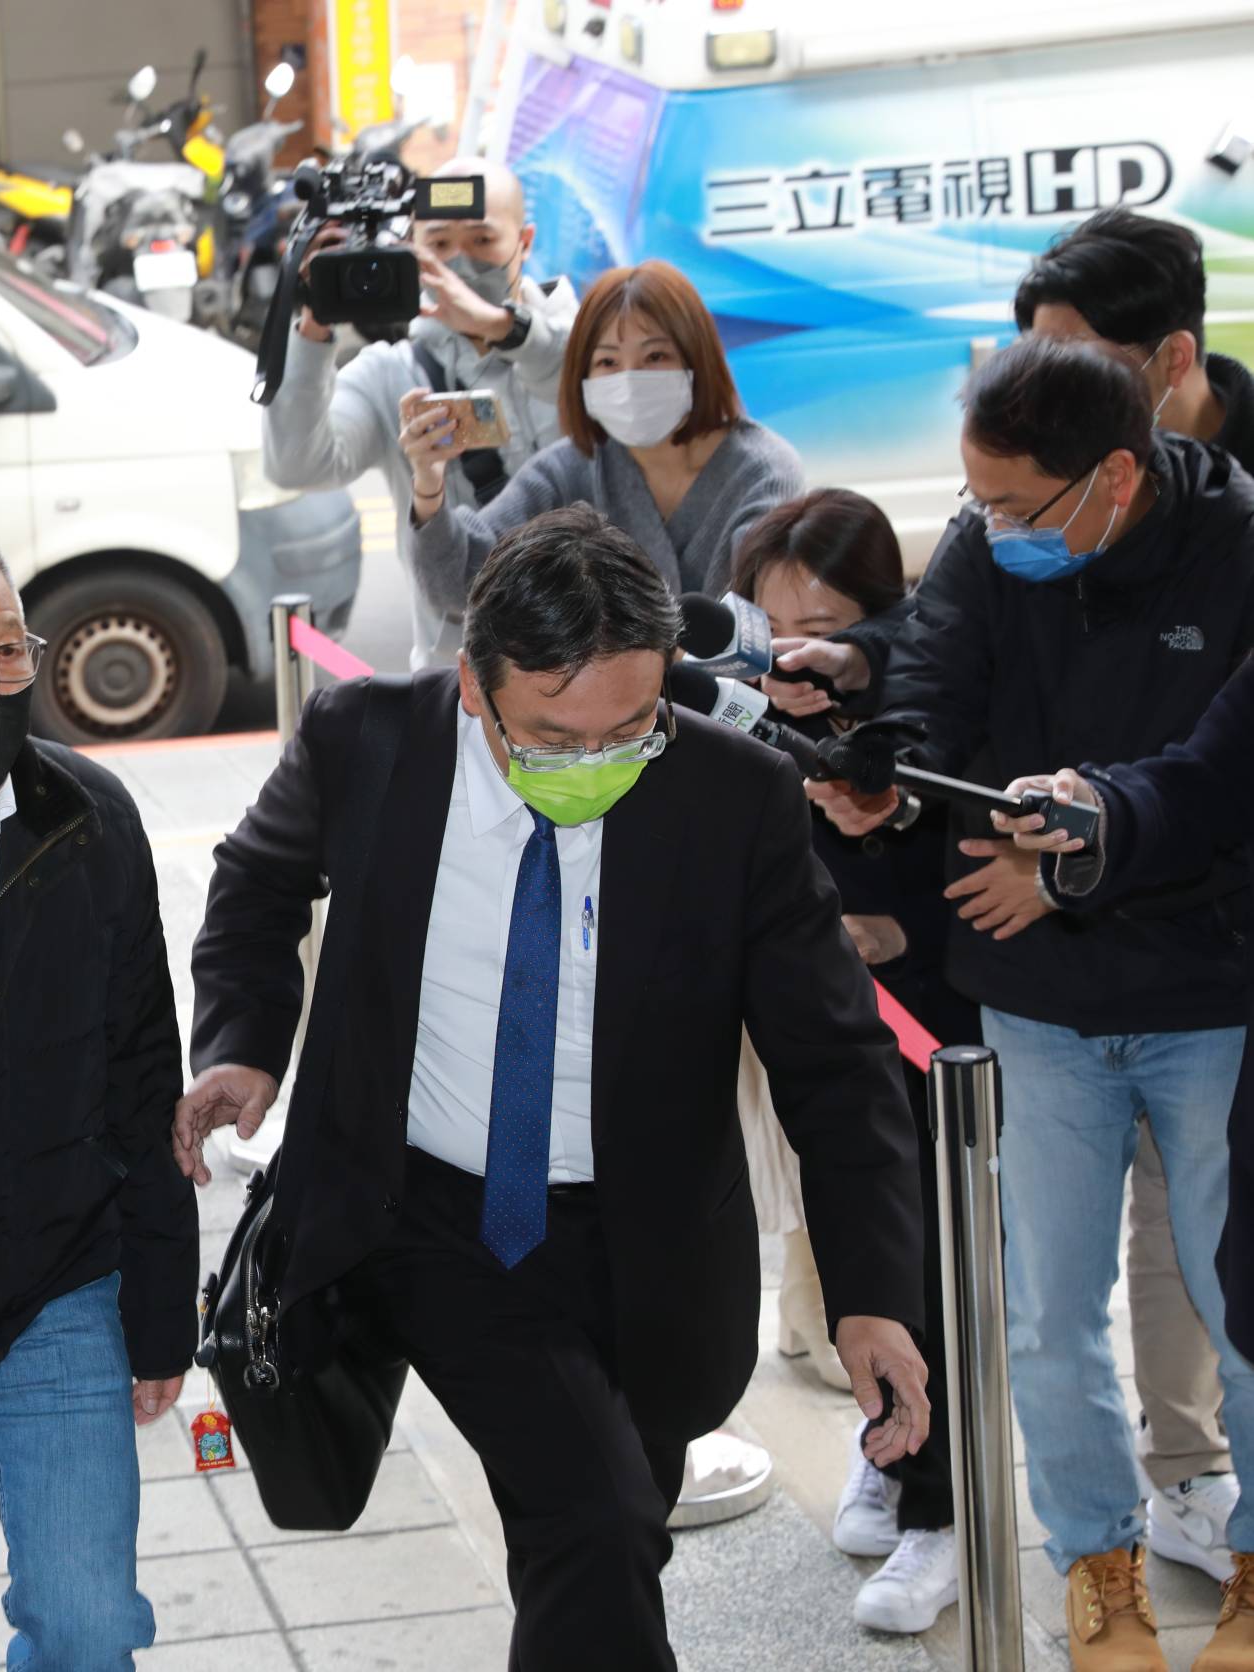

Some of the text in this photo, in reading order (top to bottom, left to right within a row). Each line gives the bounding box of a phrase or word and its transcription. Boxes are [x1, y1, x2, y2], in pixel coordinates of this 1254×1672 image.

[707, 141, 1174, 236] 三立電視 HD
[1174, 625, 1192, 634] THE
